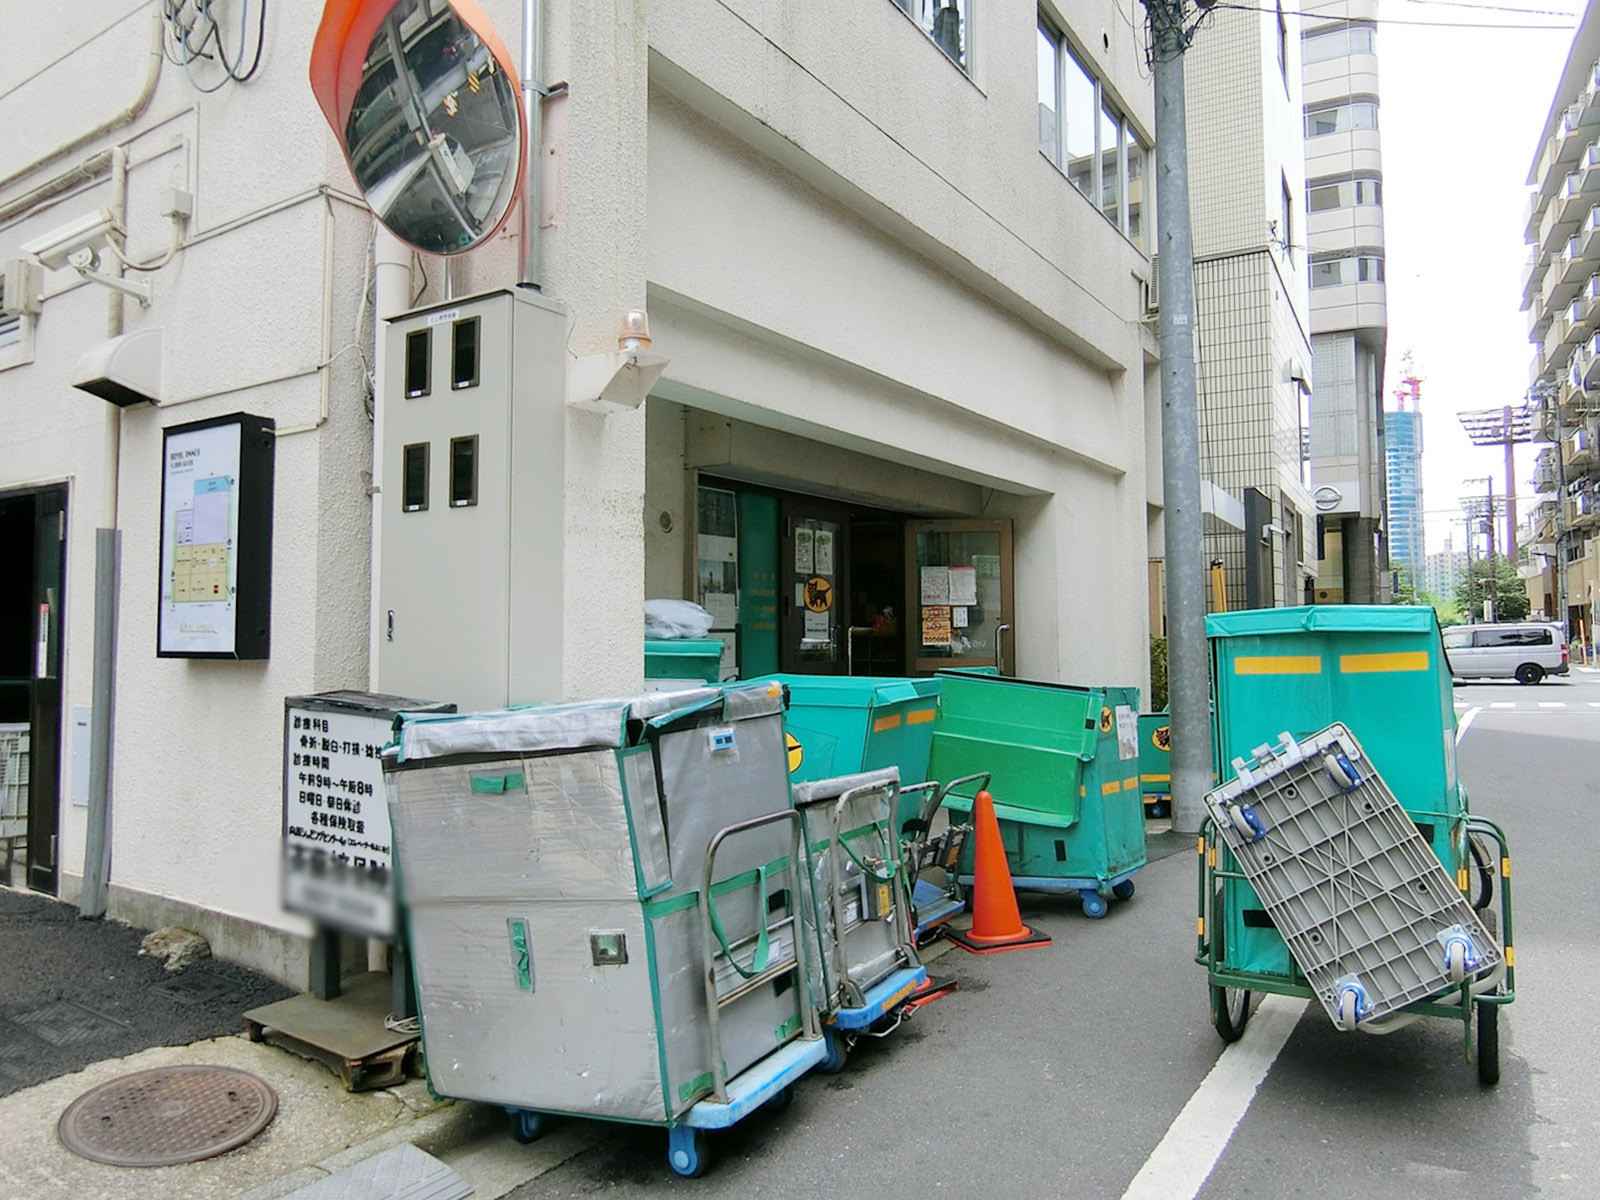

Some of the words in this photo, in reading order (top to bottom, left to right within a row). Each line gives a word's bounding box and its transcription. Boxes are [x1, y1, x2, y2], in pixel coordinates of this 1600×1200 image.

[293, 715, 329, 733] 診療科目
[293, 752, 330, 771] 診療時間
